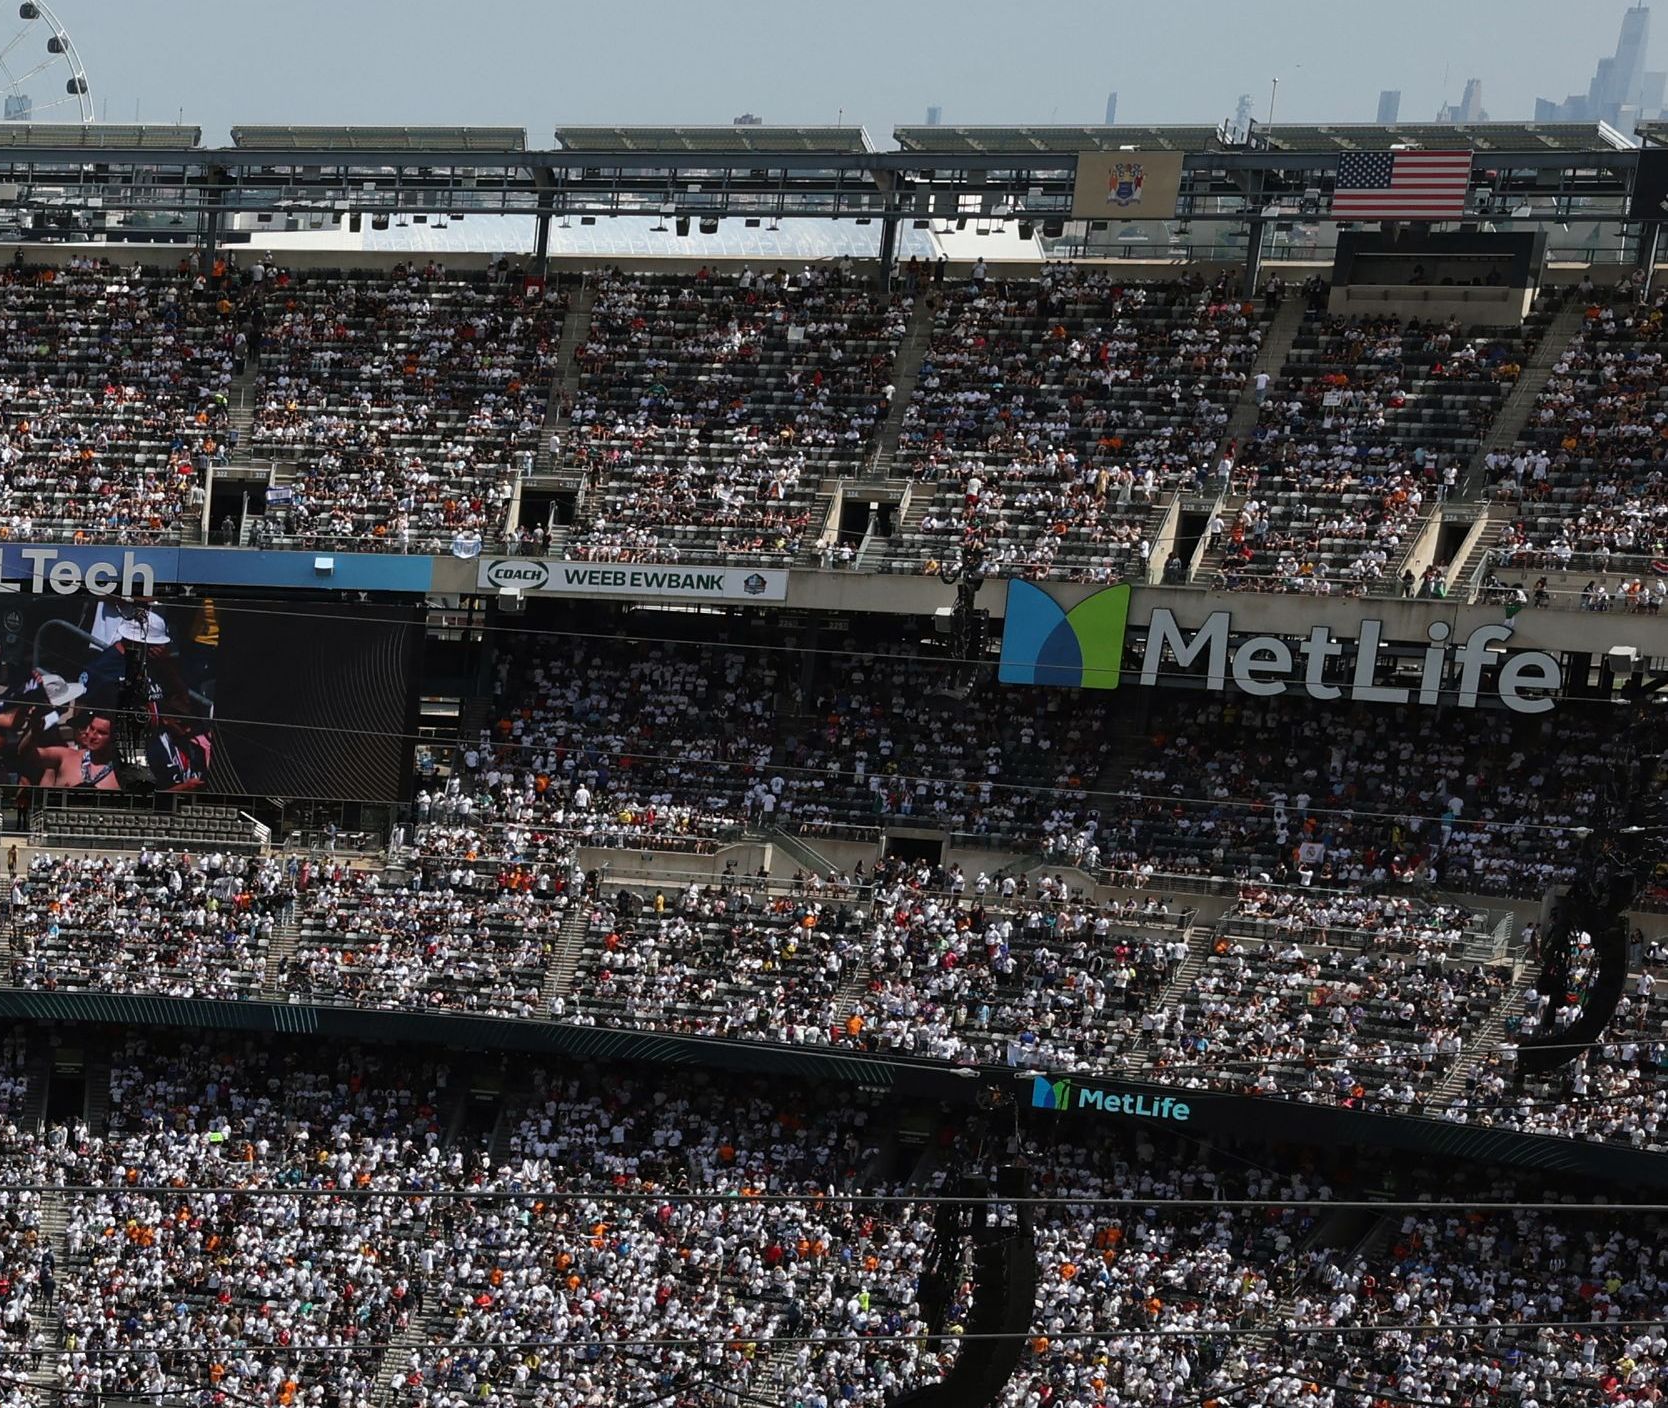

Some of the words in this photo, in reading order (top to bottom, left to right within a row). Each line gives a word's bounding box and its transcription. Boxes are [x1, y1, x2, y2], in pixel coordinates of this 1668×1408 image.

[494, 567, 543, 581] COACH
[564, 568, 626, 587] WEEB
[629, 571, 723, 592] EWBANK
[1139, 607, 1562, 713] MetLife
[1077, 1087, 1191, 1122] MetLife
